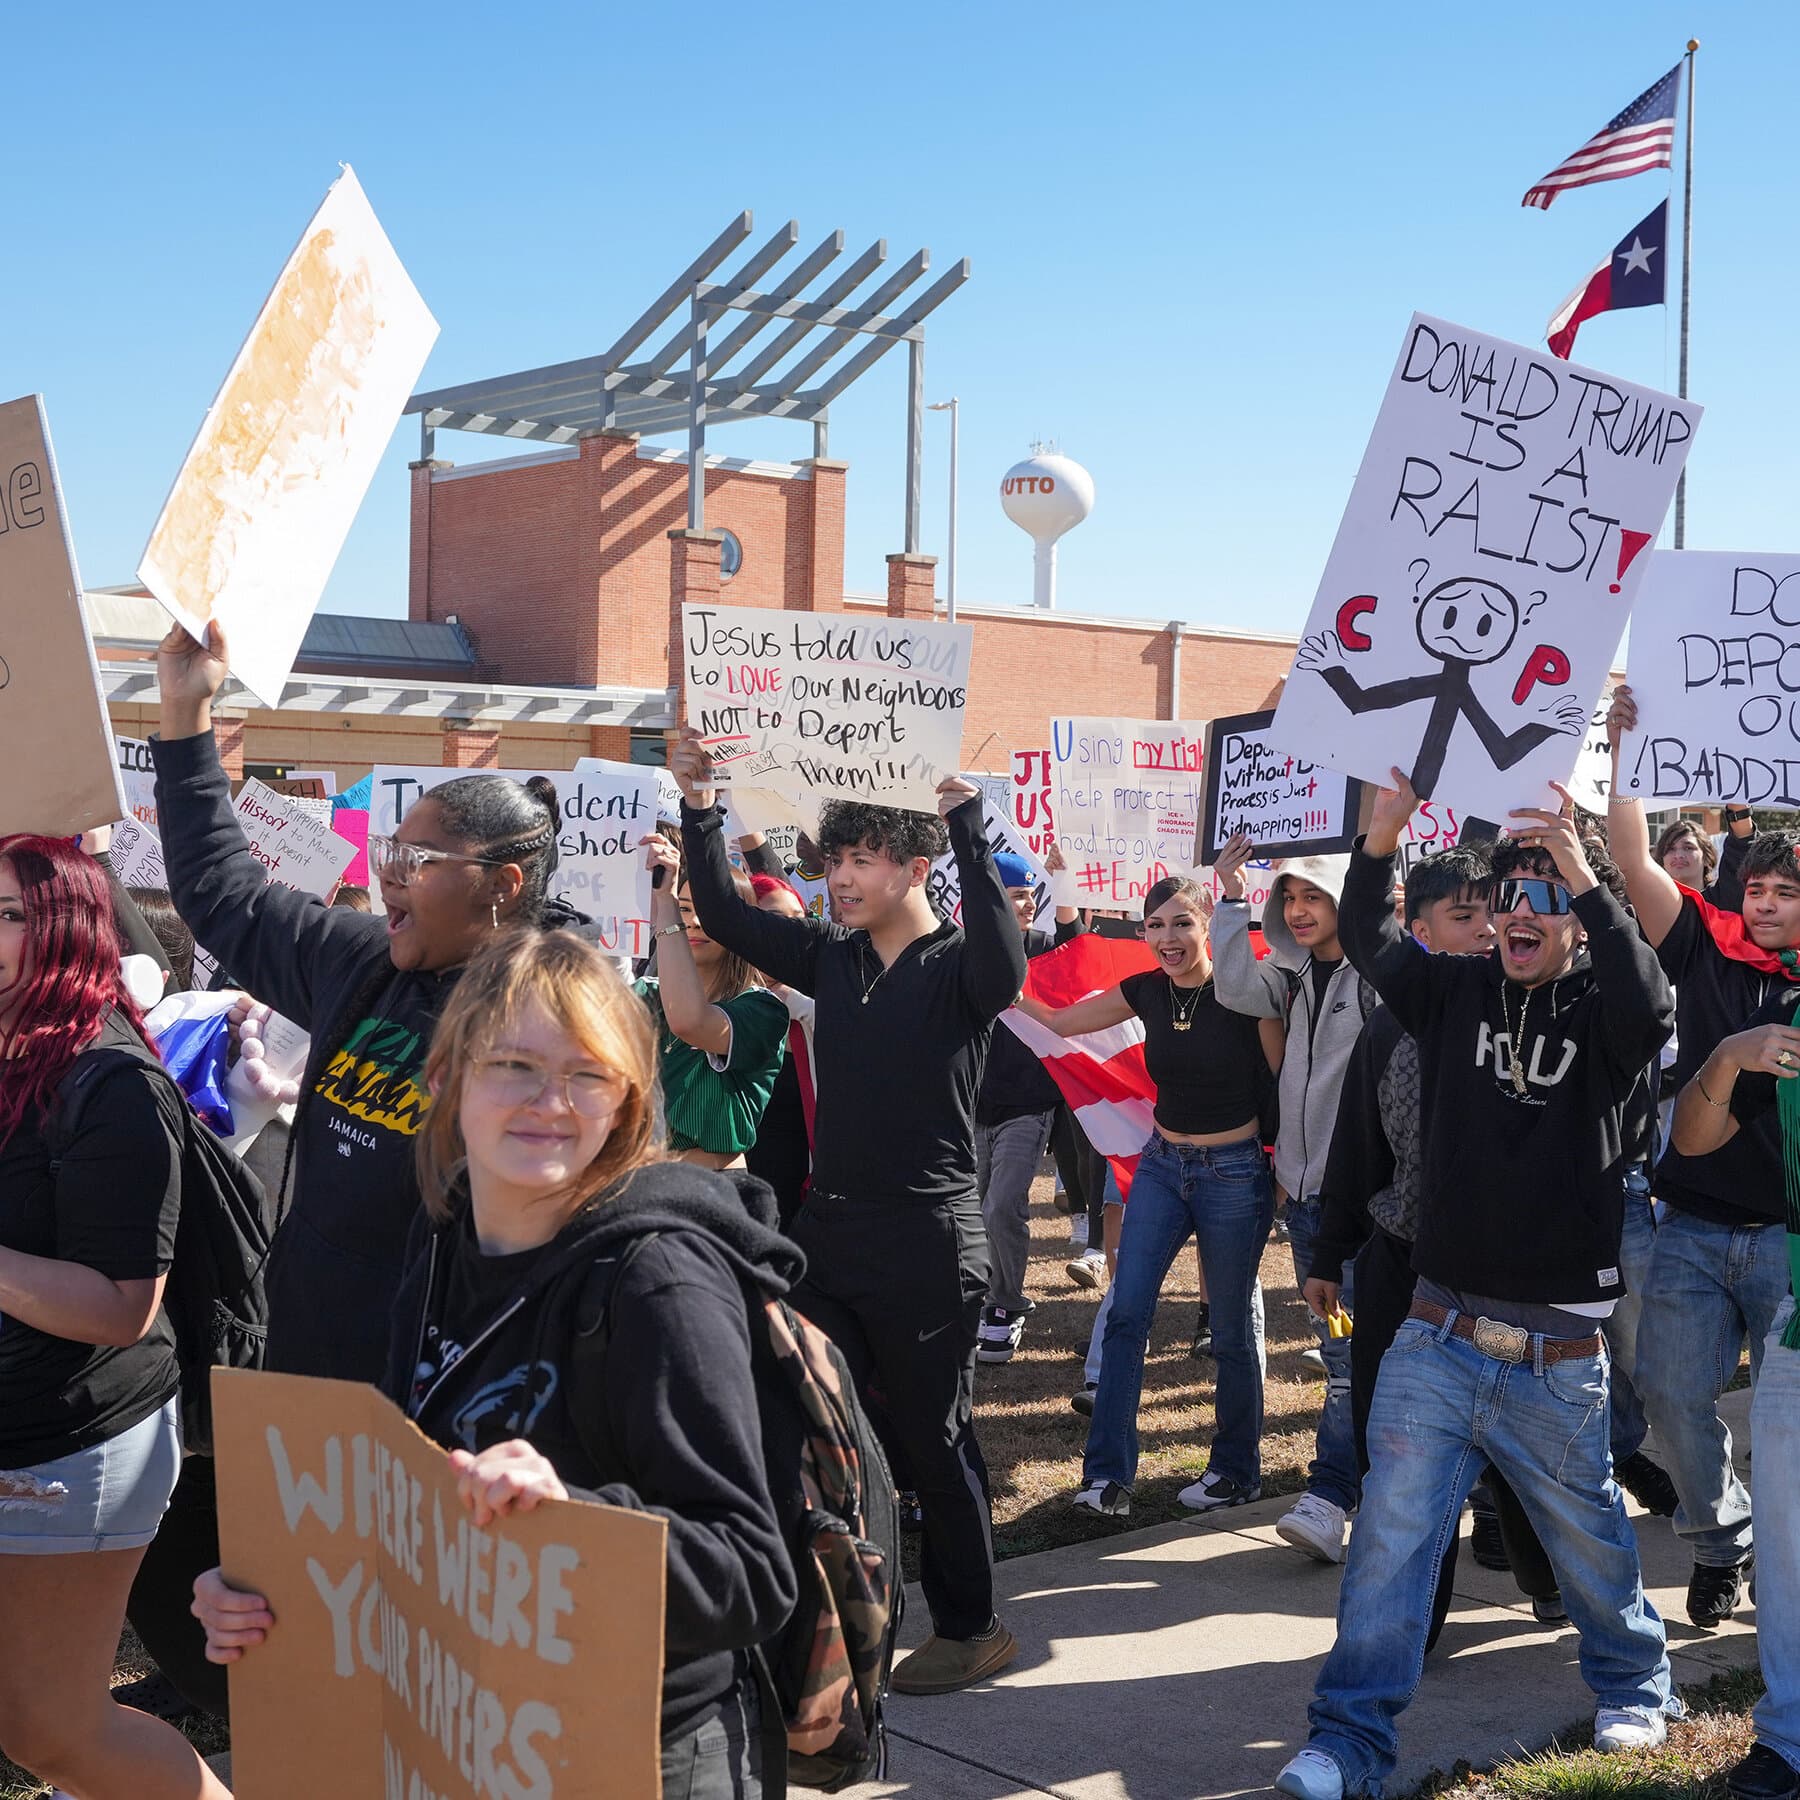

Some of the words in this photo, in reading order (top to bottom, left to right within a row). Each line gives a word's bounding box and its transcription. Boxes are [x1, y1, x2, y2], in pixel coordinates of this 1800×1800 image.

[1402, 324, 1559, 421] DONALD
[1568, 374, 1691, 465] TRUMP
[1449, 411, 1526, 471] IS
[1541, 446, 1588, 498] A
[1005, 477, 1055, 496] UTTO
[689, 611, 782, 658] Jesus
[790, 623, 858, 661] told
[876, 637, 912, 669] us
[691, 665, 719, 686] to
[727, 665, 783, 697] LOVE
[792, 675, 834, 701] Our
[842, 676, 966, 719] Neighbors
[701, 708, 749, 737] NOT
[757, 707, 782, 729] to
[798, 709, 906, 754] Deport
[1133, 739, 1164, 768] my
[1225, 756, 1294, 789] Without
[791, 758, 907, 791] Them!!!
[1059, 766, 1103, 808] help
[1113, 780, 1175, 812] protect
[564, 783, 648, 822] dent
[1221, 790, 1267, 813] Process
[1269, 787, 1280, 804] is
[291, 828, 303, 842] to
[1156, 826, 1180, 834] CHAOS
[1180, 828, 1195, 836] EVIL
[1157, 819, 1195, 827] IGNORANCE
[1060, 824, 1098, 853] had
[1105, 824, 1127, 850] to
[1132, 835, 1168, 864] give
[328, 1116, 377, 1150] JAMAICA
[265, 1424, 423, 1586] WHERE
[433, 1489, 580, 1665] WERE
[306, 1556, 412, 1712] YOUR
[418, 1626, 562, 1800] PAPERS
